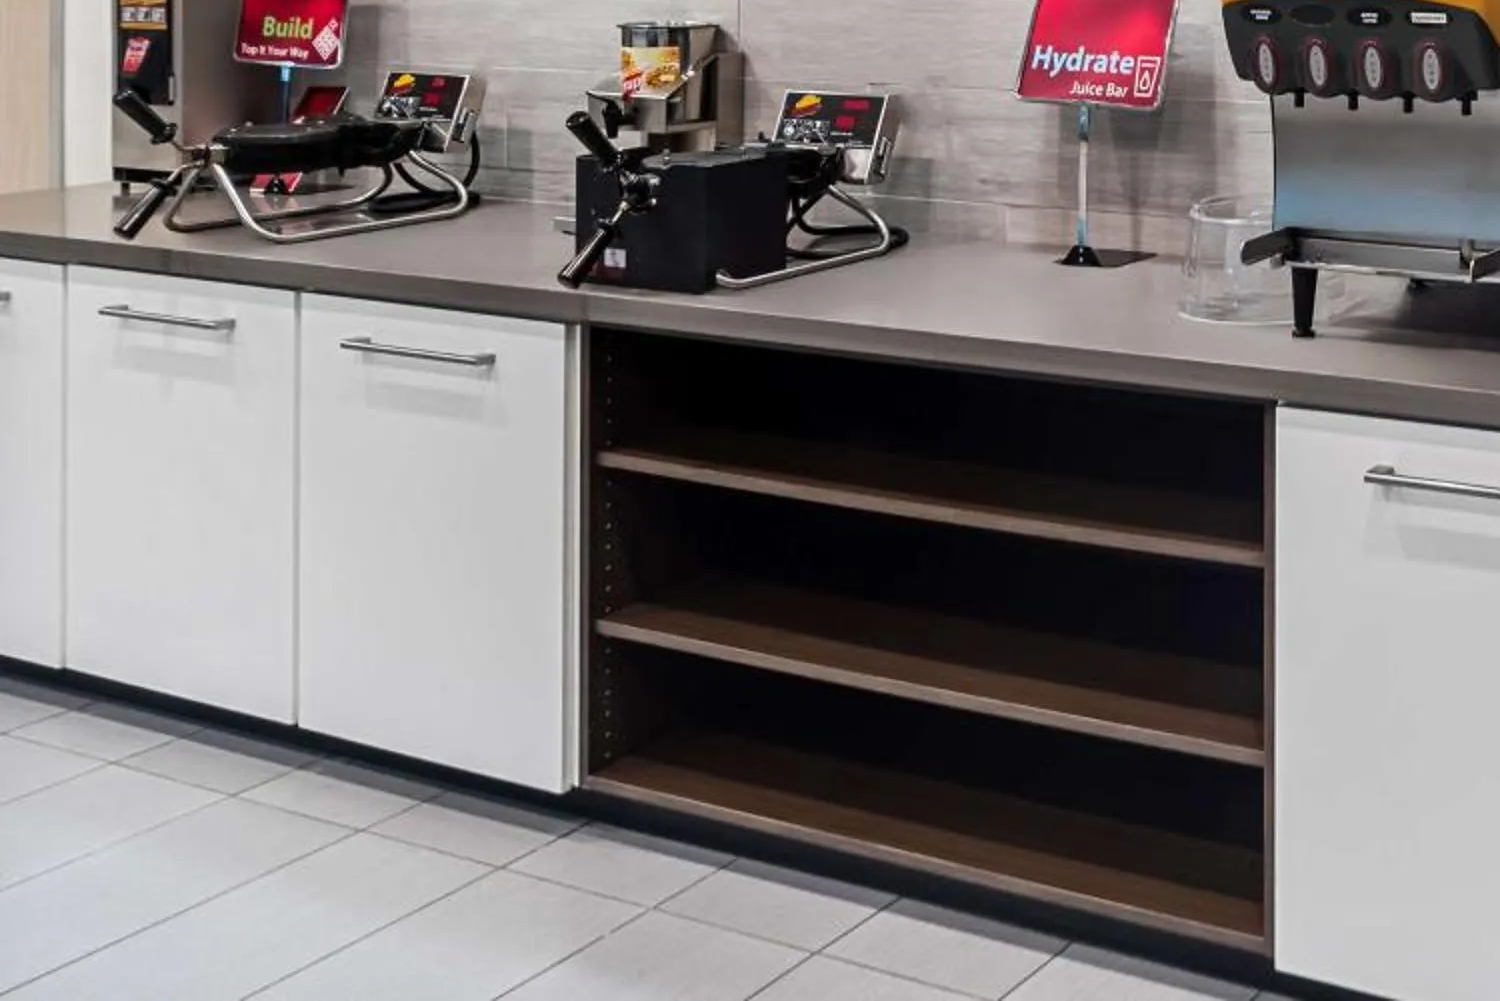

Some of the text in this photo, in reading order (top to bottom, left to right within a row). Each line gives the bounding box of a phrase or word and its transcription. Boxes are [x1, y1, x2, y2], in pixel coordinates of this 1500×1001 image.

[263, 16, 314, 39] Build
[241, 42, 259, 56] Top
[267, 45, 289, 56] Your
[289, 46, 309, 60] Way
[1031, 45, 1135, 78] Hydrate
[1069, 80, 1129, 98] Juice Bar
